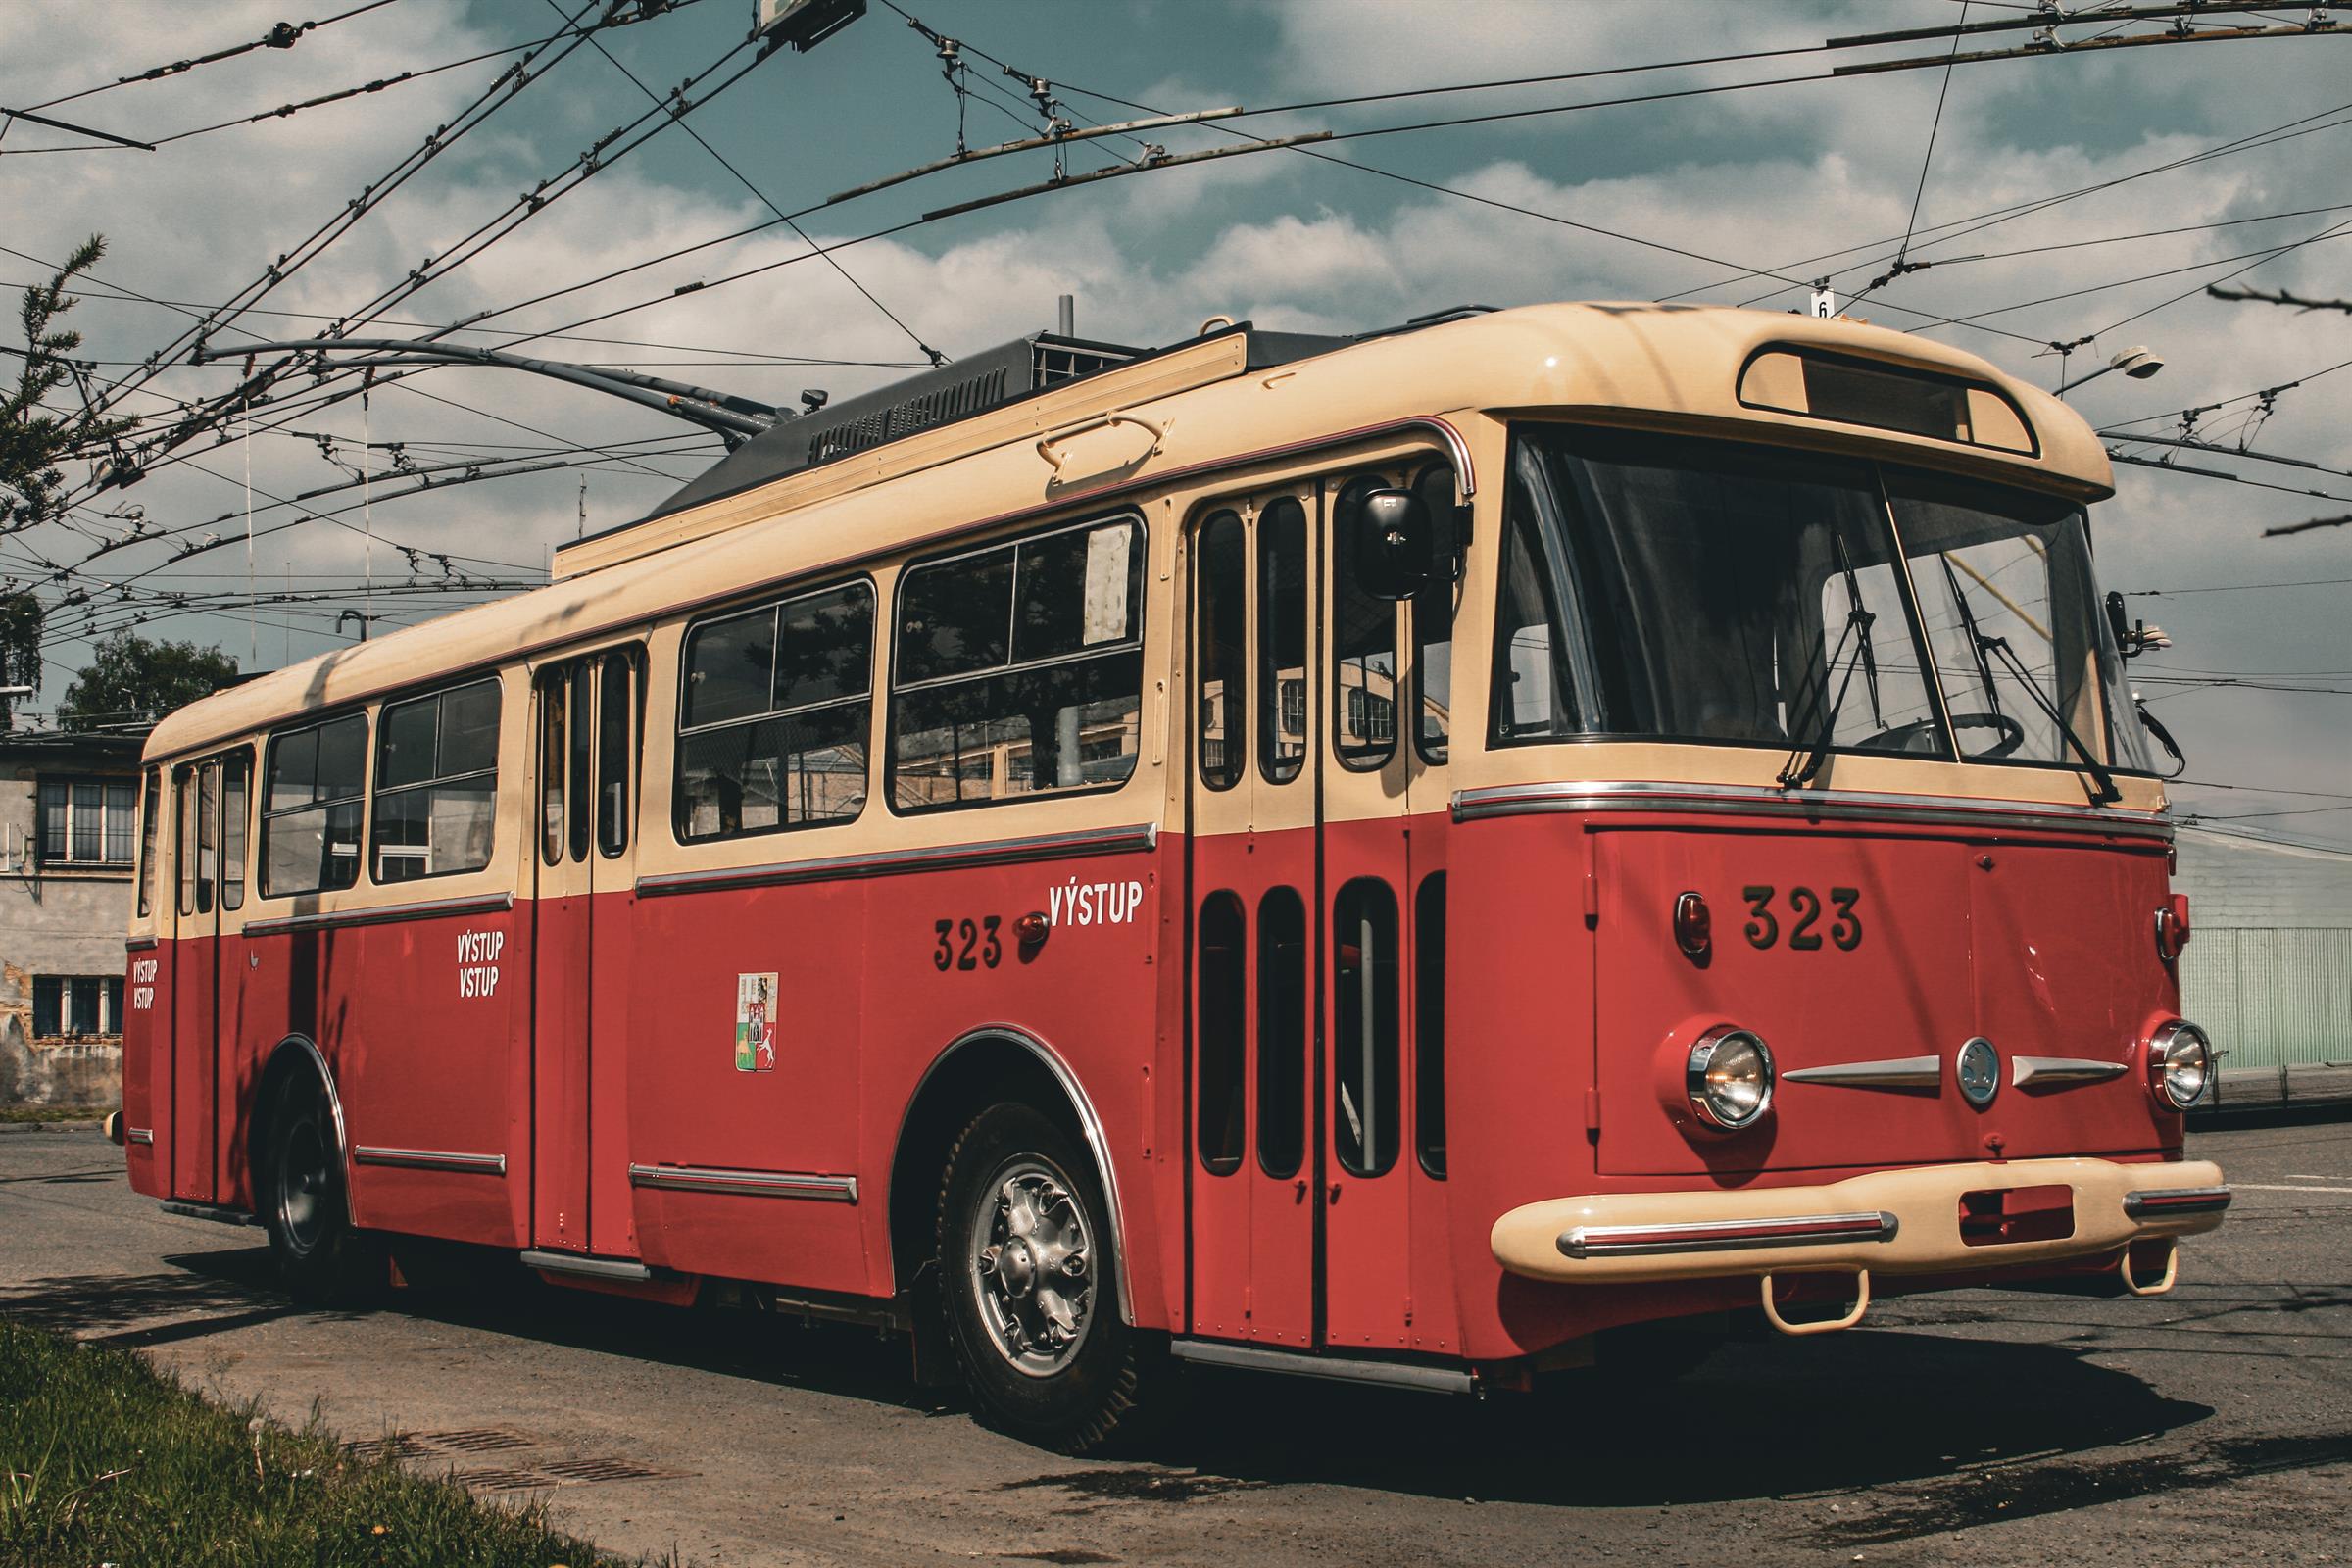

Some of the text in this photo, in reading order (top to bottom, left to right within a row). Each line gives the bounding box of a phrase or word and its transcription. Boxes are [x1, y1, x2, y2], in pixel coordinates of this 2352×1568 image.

[1819, 301, 1827, 318] 6
[1050, 876, 1144, 926] VÝSTUP
[1742, 885, 1862, 952] 323
[457, 928, 504, 963] VÝSTUP
[934, 915, 1002, 972] 323
[133, 957, 157, 984] VÝSTUP
[460, 965, 499, 998] VSTUP
[133, 987, 154, 1009] VSTUP
